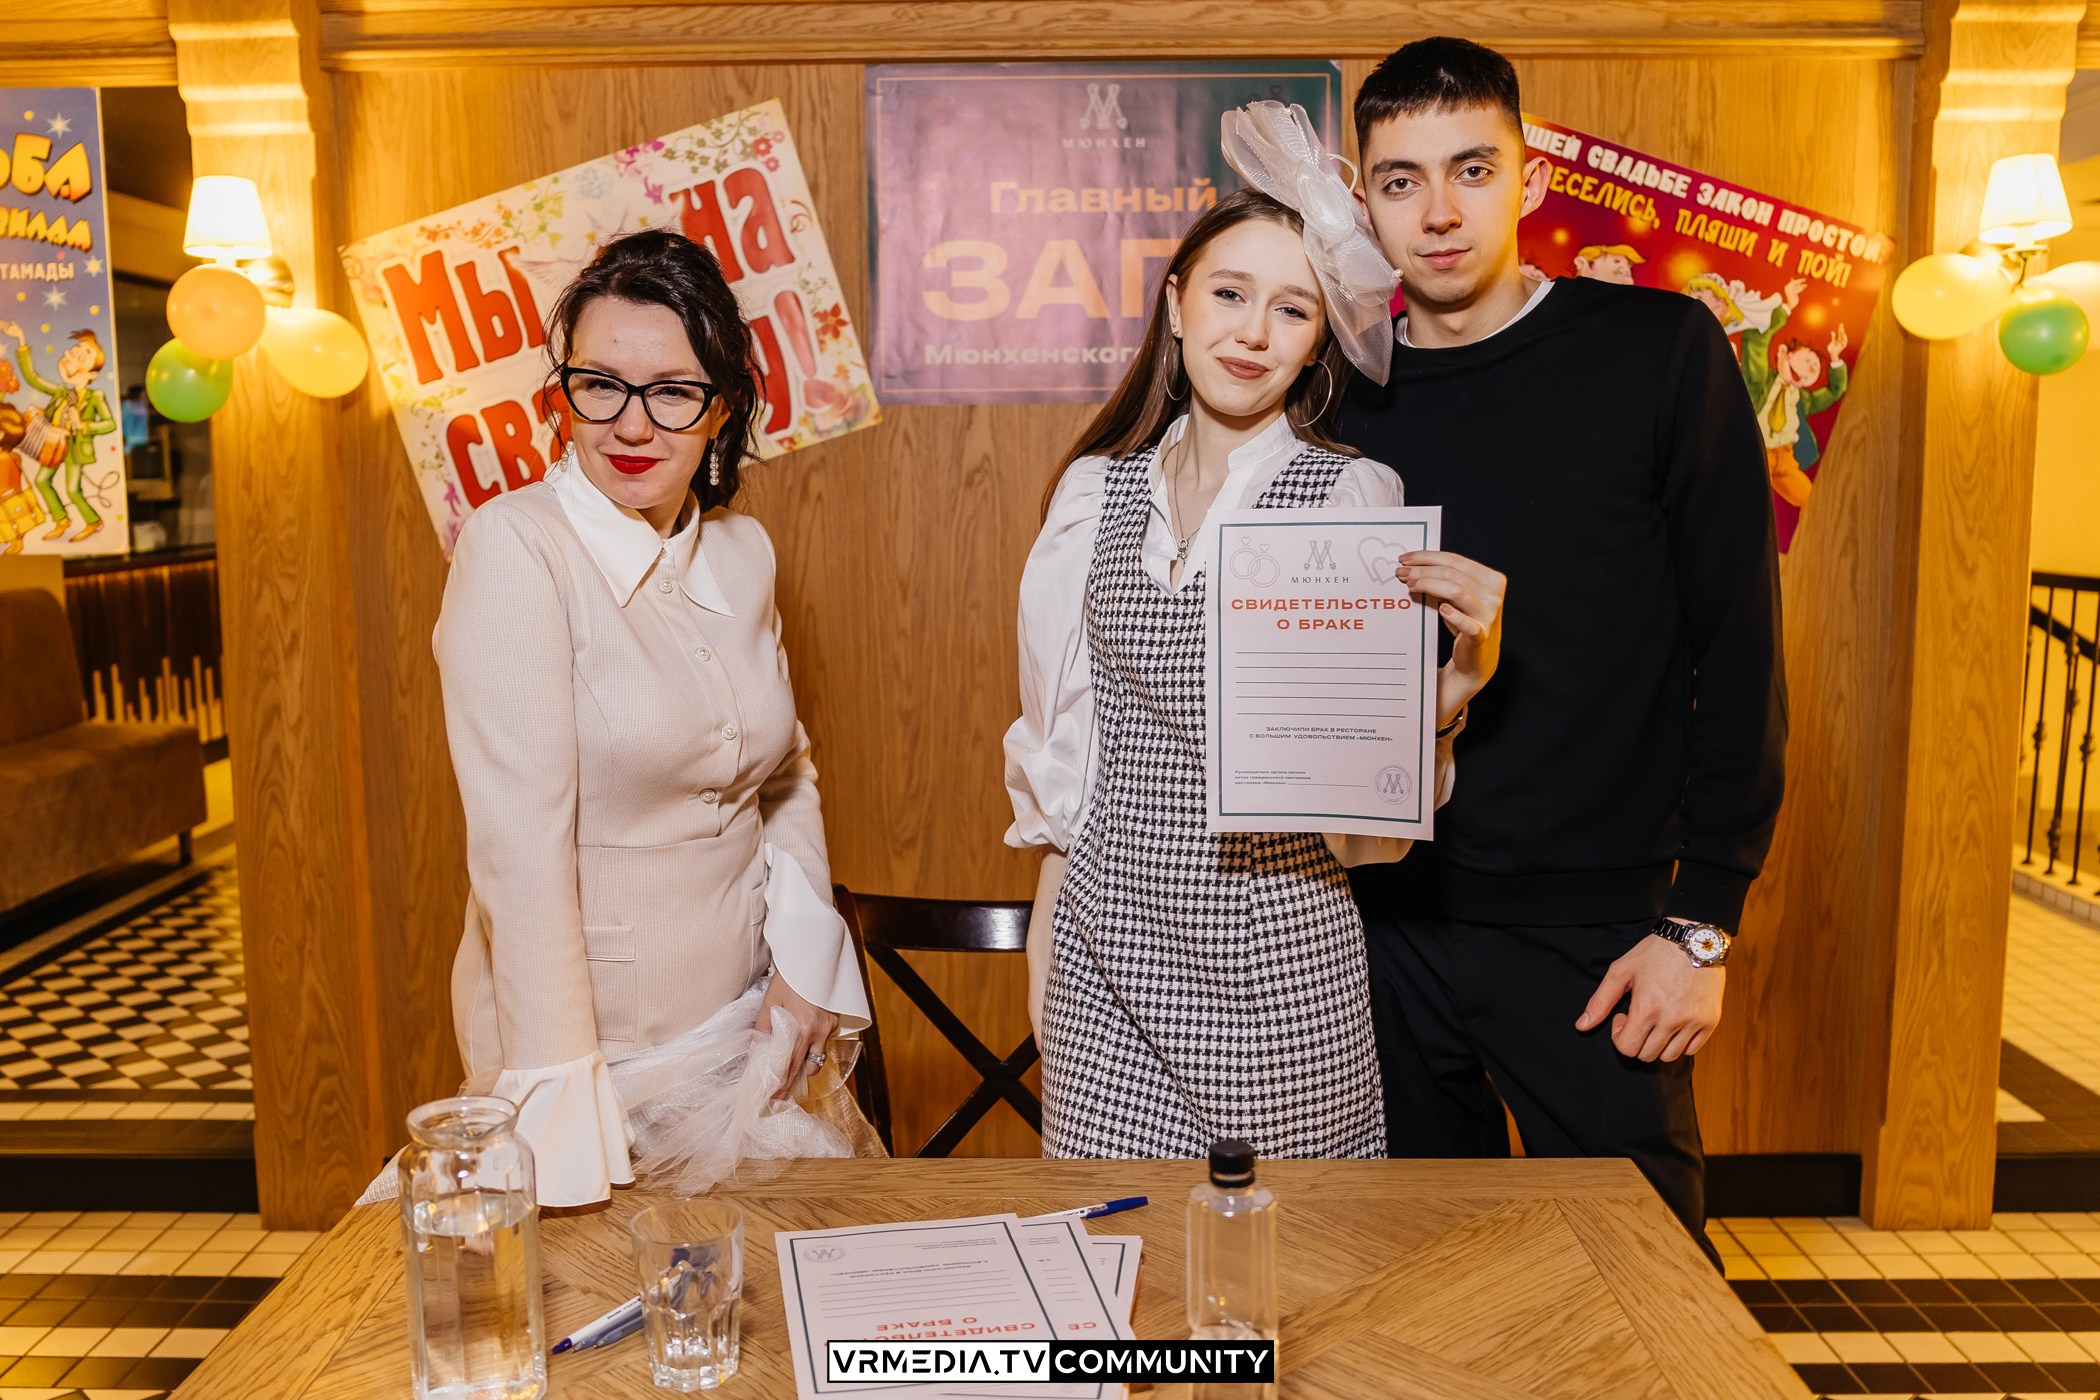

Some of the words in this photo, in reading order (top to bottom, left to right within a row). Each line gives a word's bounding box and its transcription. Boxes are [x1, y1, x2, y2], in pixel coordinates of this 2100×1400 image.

[1061, 136, 1147, 149] МЮНХЕН
[1586, 144, 1693, 200] СВАДЬБЕ
[1696, 182, 1775, 227] ЗАКОН
[989, 177, 1218, 215] Главный
[1548, 165, 1661, 230] ЕСЕЛИСЬ,
[1674, 208, 1759, 258] ПЛЯШИ
[1767, 238, 1790, 268] И
[1797, 249, 1853, 288] ПОЙ!
[1231, 598, 1411, 611] СВИДЕТЕЛЬСТВО
[1277, 619, 1290, 630] О
[1298, 618, 1364, 630] БРАКЕ
[876, 1318, 953, 1331] БРАКЕ
